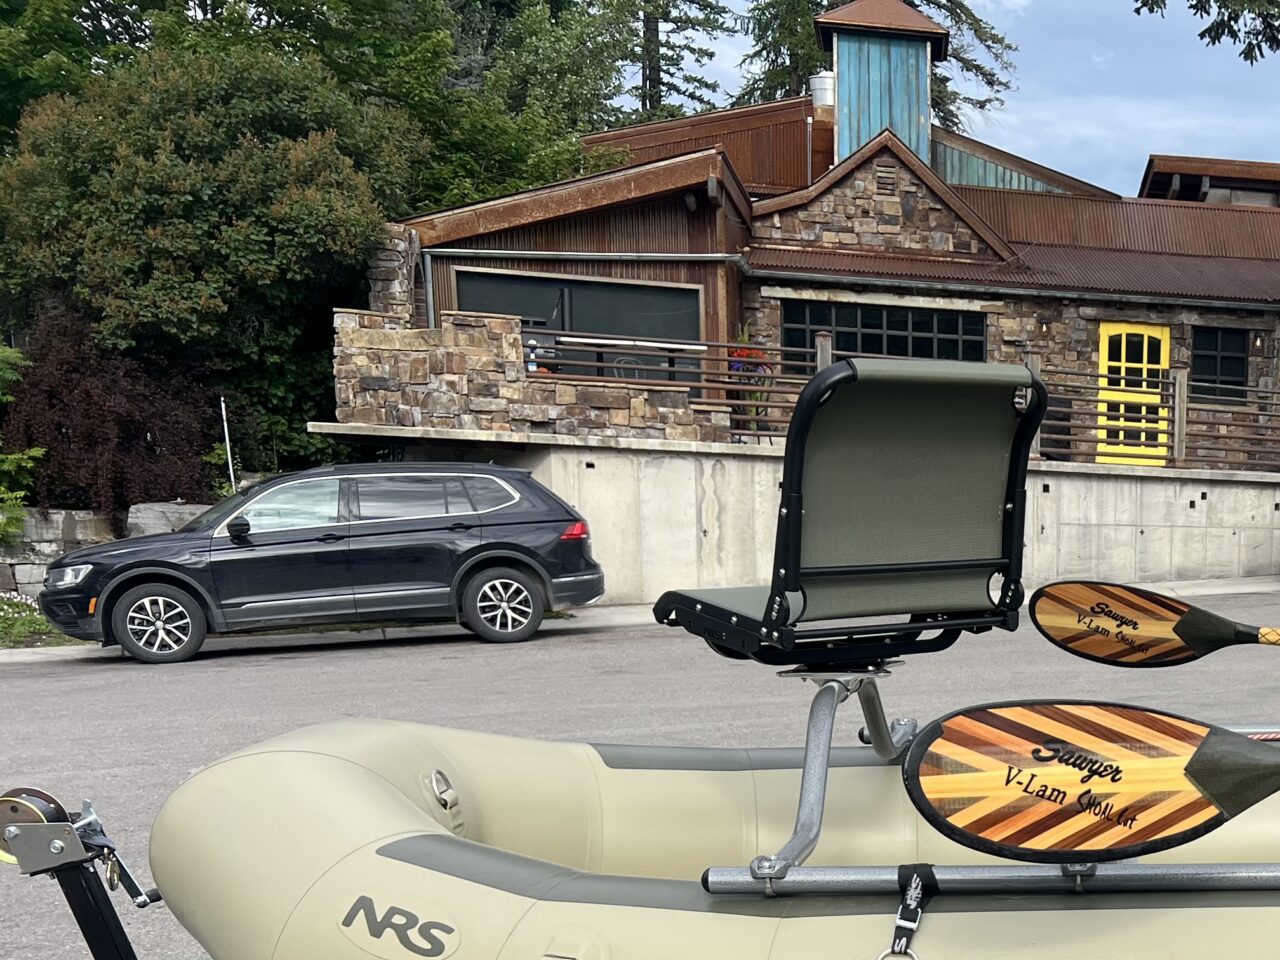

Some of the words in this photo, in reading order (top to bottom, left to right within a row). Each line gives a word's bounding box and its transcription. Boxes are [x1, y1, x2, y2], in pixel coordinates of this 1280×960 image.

[1076, 613, 1110, 637] V-Lam
[1090, 602, 1139, 630] Sawyer
[1031, 739, 1123, 784] Sawyer
[1004, 765, 1067, 805] V-Lam
[341, 895, 456, 957] NRS
